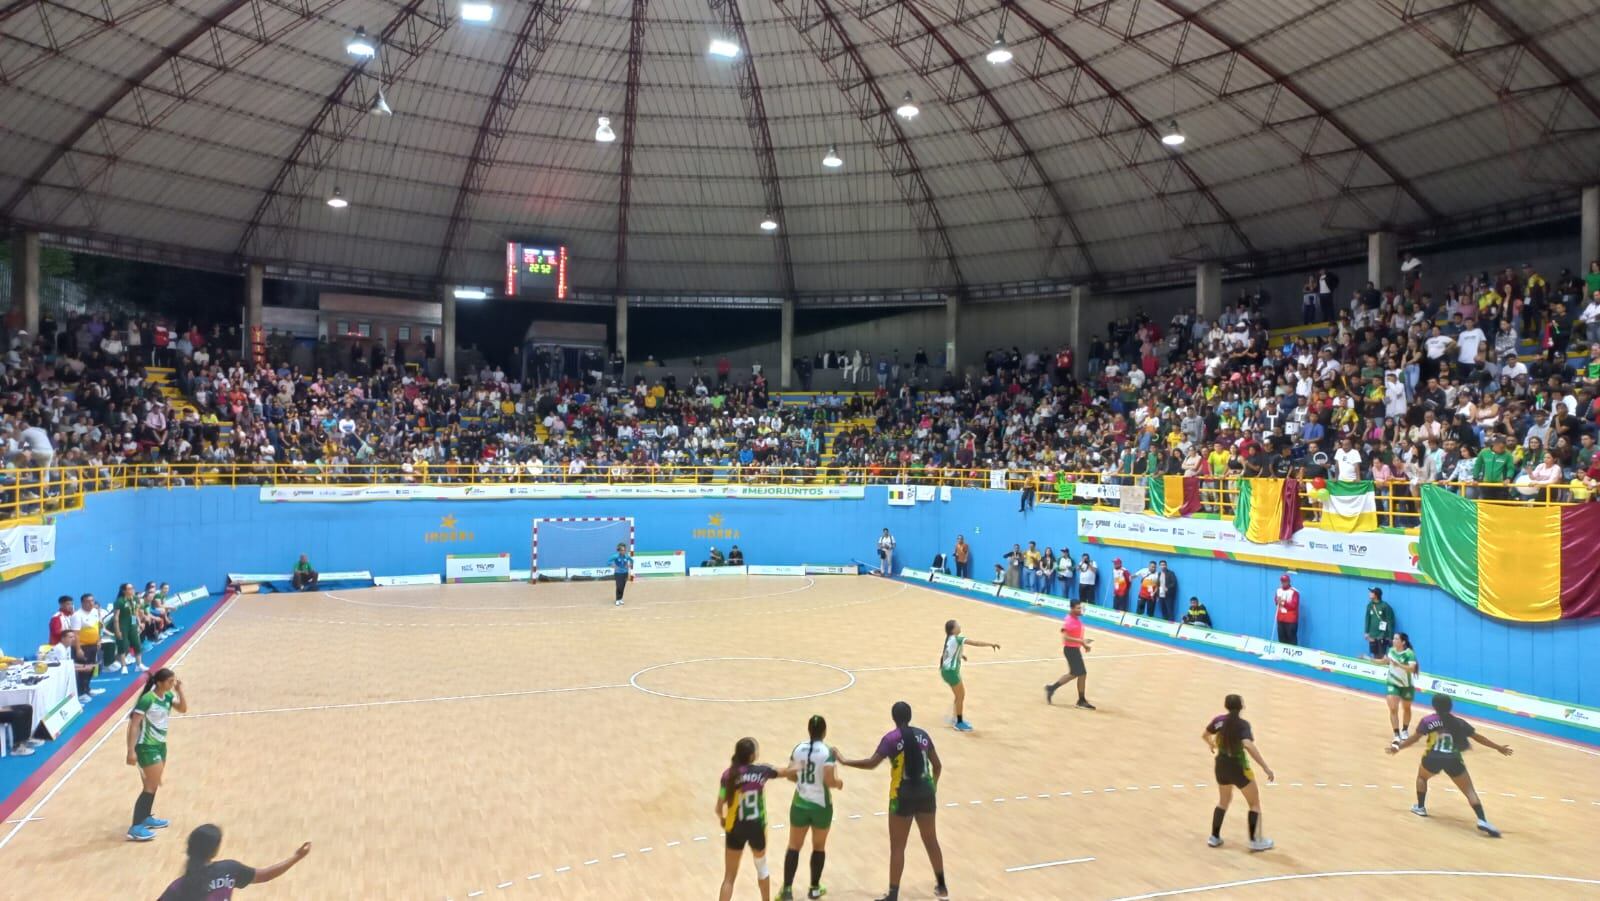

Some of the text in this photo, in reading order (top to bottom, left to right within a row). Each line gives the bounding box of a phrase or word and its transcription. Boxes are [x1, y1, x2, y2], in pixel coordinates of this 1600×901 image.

[742, 487, 824, 496] #MEJORJUNTOS
[1434, 732, 1453, 753] 10
[800, 760, 816, 784] 18
[738, 790, 759, 821] 19
